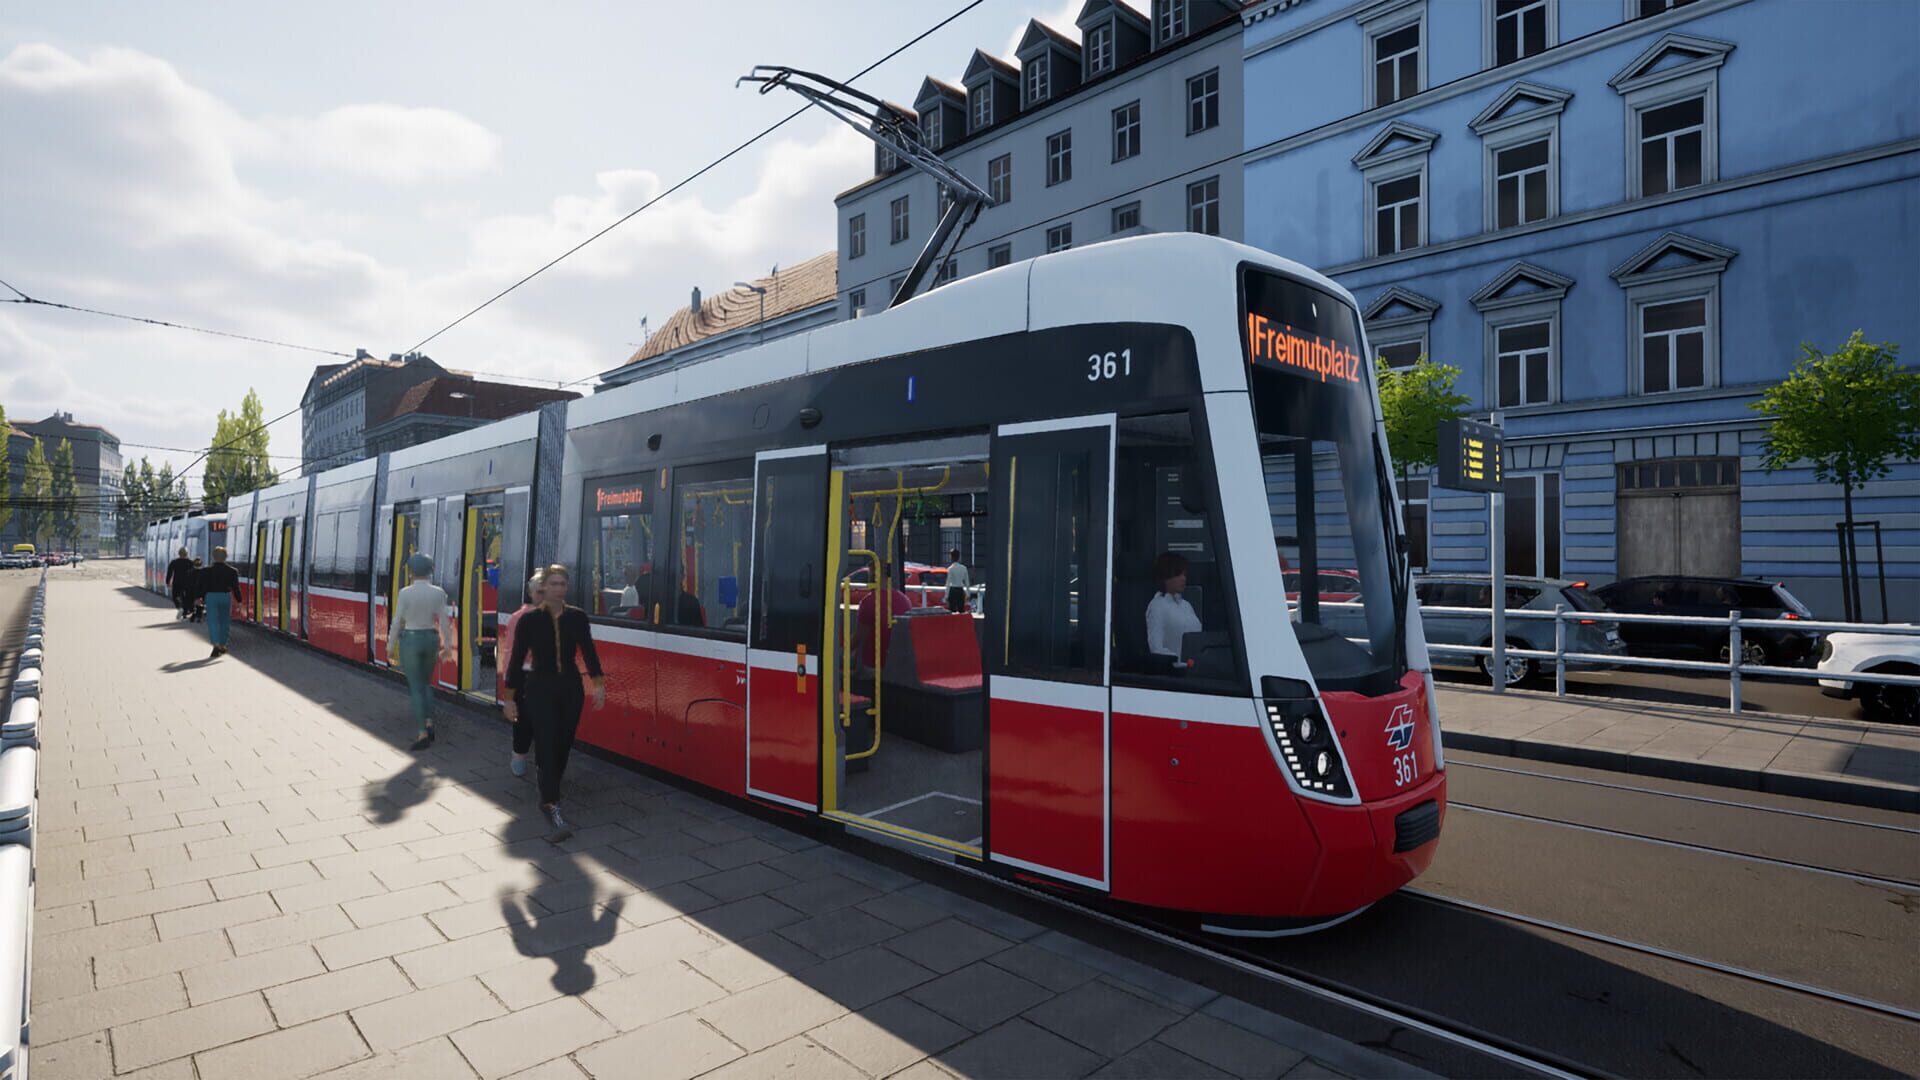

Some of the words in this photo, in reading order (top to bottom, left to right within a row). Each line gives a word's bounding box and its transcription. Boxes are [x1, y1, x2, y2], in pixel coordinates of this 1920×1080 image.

[1087, 348, 1131, 381] 361
[1255, 314, 1360, 383] Freimutplatz
[1393, 751, 1418, 787] 361
